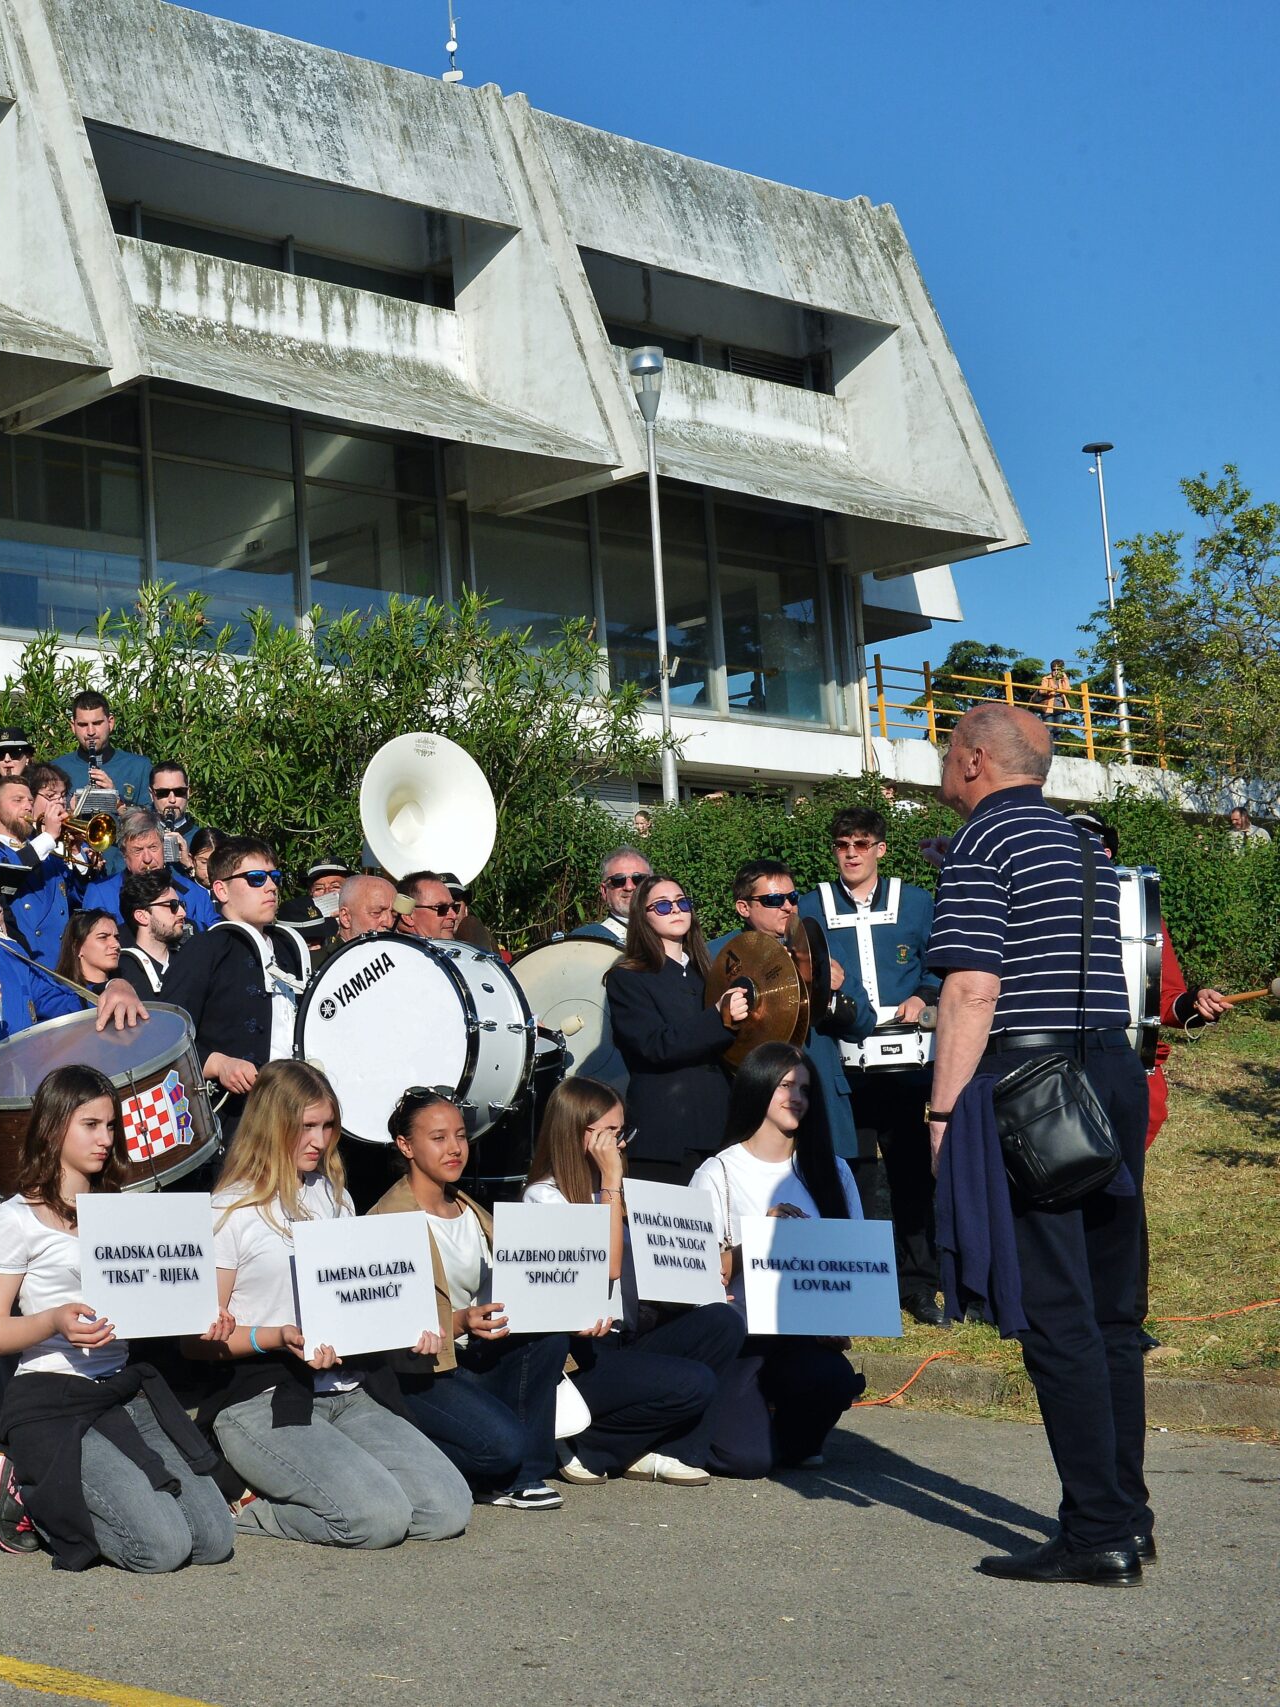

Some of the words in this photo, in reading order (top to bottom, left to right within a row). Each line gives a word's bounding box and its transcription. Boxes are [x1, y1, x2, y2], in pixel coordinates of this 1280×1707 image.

[333, 952, 396, 1007] YAMAHA
[633, 1212, 673, 1229] PUHAČKI
[674, 1218, 714, 1233] ORKESTAR
[646, 1234, 675, 1248] KUD-A
[675, 1237, 706, 1251] "SLOGA"
[94, 1246, 154, 1261] GRADSKA
[157, 1244, 203, 1258] GLAZBA
[496, 1249, 556, 1263] GLAZBENO
[558, 1246, 607, 1263] DRUŠTVO
[653, 1254, 683, 1269] RAVNA
[684, 1258, 707, 1271] GORA
[751, 1256, 816, 1272] PUHAČKI
[818, 1260, 890, 1273] ORKESTAR
[102, 1269, 150, 1284] "TRSAT"
[160, 1268, 199, 1285] RIJEKA
[317, 1265, 366, 1283] LIMENA
[368, 1261, 416, 1277] GLAZBA
[525, 1267, 579, 1285] "SPINČIĆI"
[336, 1282, 402, 1304] "MARINIĆI"
[793, 1279, 851, 1293] LOVRAN
